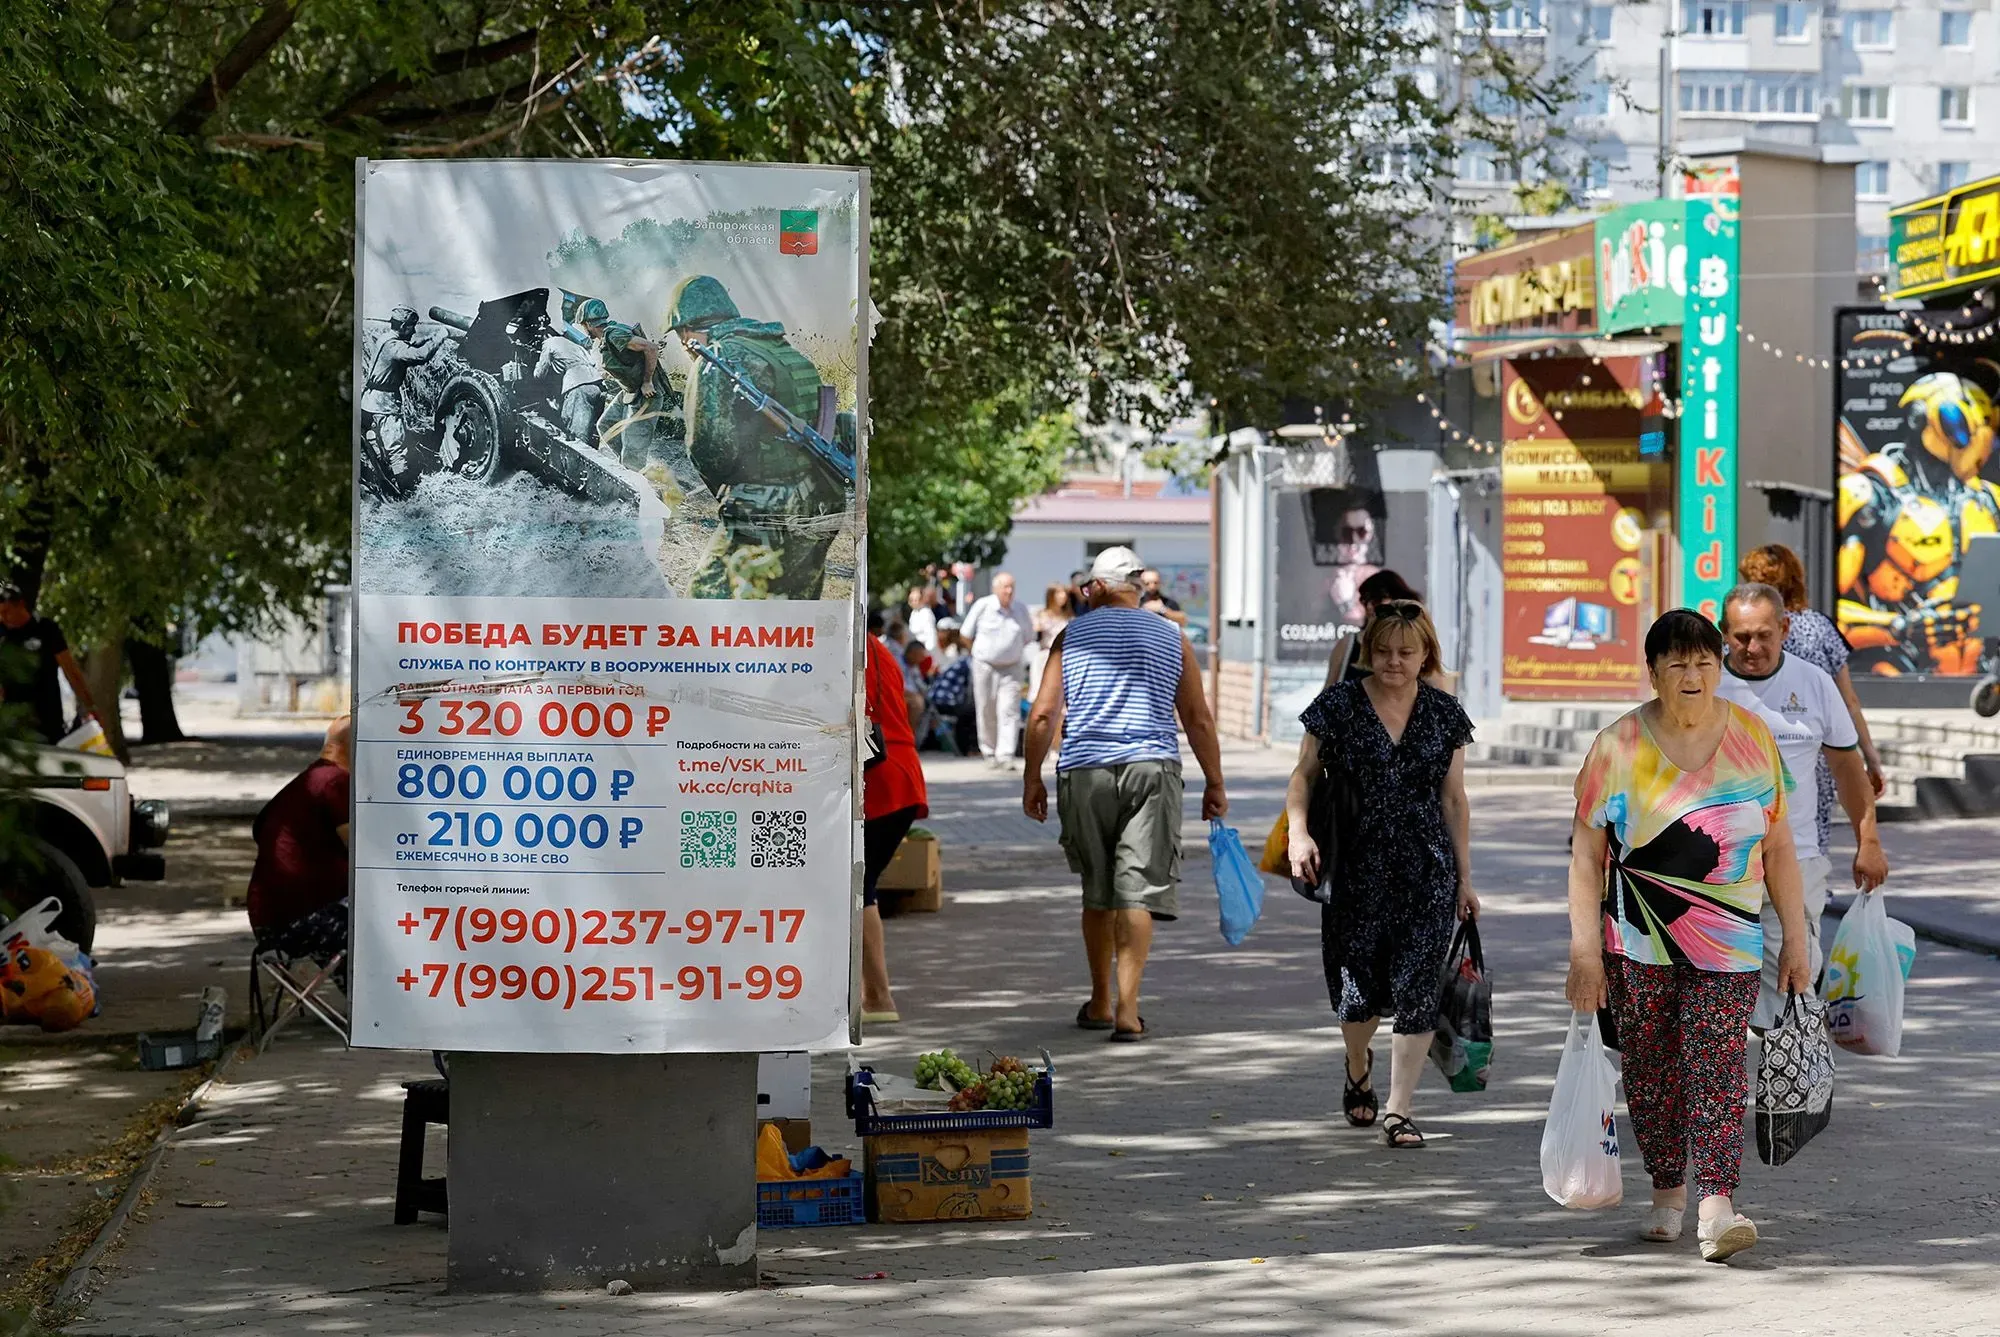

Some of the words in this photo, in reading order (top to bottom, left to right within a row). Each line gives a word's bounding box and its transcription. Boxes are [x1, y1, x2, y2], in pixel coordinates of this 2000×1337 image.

[694, 219, 775, 232] Запорожская
[727, 233, 775, 245] область
[1869, 382, 1904, 396] POCO
[1865, 417, 1904, 431] acer
[398, 622, 532, 649] ПОБЕДА
[543, 624, 647, 650] БУДЕТ
[657, 625, 700, 648] ЗА
[711, 626, 814, 650] НАМИ!
[1281, 622, 1336, 642] СОЗДАЙ
[398, 658, 464, 671] СЛУЖБА
[469, 659, 492, 671] ПО
[496, 660, 586, 673] КОНТРАКТУ
[591, 661, 602, 673] В
[606, 662, 730, 675] ВООРУЖЕННЫХ
[735, 662, 787, 675] СИЛАХ
[792, 663, 813, 675] РФ
[399, 683, 486, 694] ЗАРОТНАЯ
[536, 685, 554, 695] ЗА
[558, 683, 615, 696] ПЕРВЫЙ
[619, 686, 645, 697] ГОД
[398, 700, 424, 734] 3
[438, 700, 522, 736] 320
[539, 702, 633, 738] 000
[646, 706, 671, 737] ₽
[676, 739, 750, 752] Подробности
[753, 742, 765, 750] на
[768, 740, 801, 750] сайте:
[397, 750, 523, 762] ЕДИНОВРЕМЕННАЯ
[528, 752, 594, 763] ВЫПЛАТА
[678, 756, 807, 774] t.me/VSK_MIL
[397, 764, 487, 799] 800
[503, 765, 597, 801] 000
[611, 769, 635, 801] ₽
[678, 777, 793, 797] vk.cc/crqNta
[427, 811, 503, 847] 210
[514, 813, 609, 849] 000
[619, 817, 644, 849] ₽
[396, 851, 486, 863] ЕЖЕМЕСЯЧНО
[491, 853, 499, 863] В
[503, 853, 537, 864] ЗОНЕ
[541, 854, 569, 865] СВО
[397, 883, 442, 895] Телефон
[445, 885, 489, 897] горячей
[492, 886, 530, 896] линии:
[398, 906, 806, 954] +7(990)237-97-17
[397, 963, 803, 1010] +7(990)251-91-99
